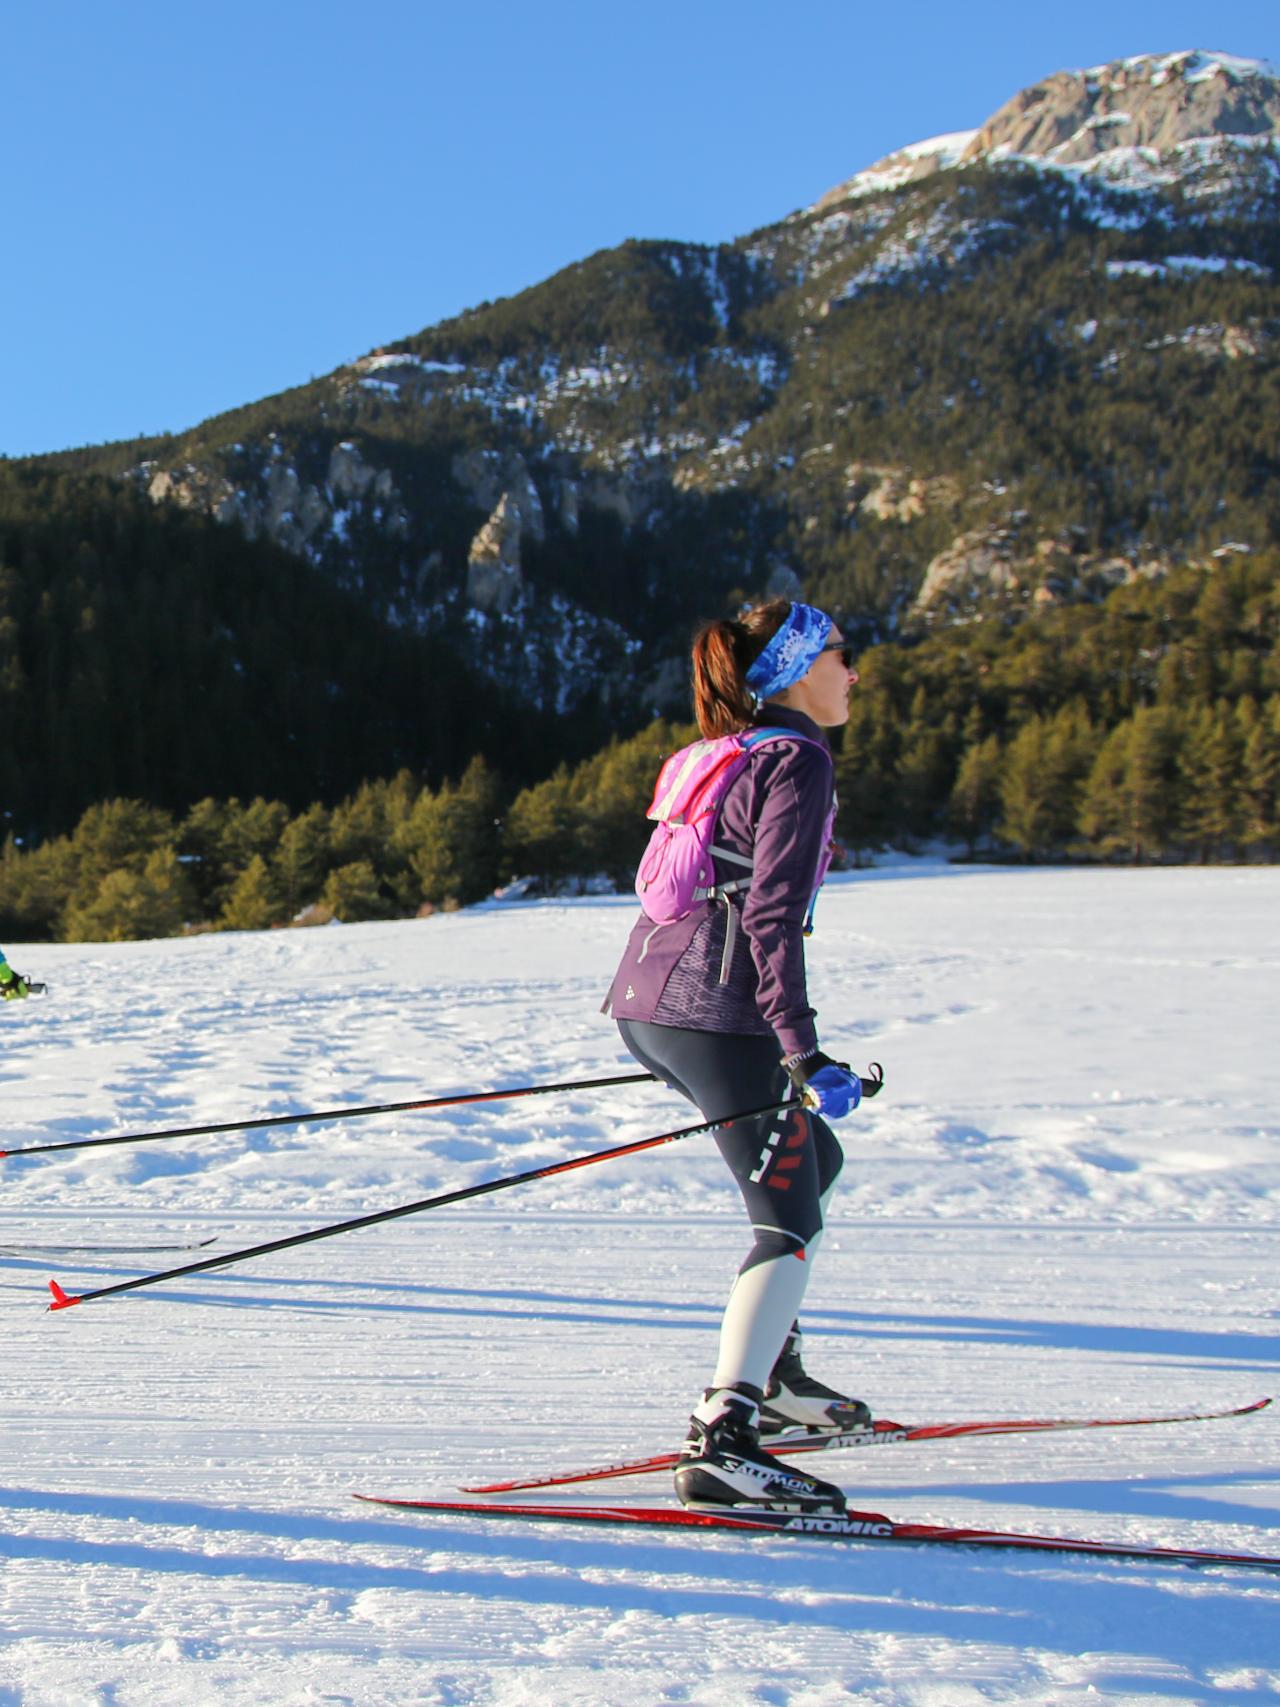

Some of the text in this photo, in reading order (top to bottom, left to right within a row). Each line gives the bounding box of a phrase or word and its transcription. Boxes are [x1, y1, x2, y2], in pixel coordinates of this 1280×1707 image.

[825, 1431, 907, 1448] ATOMIC
[722, 1459, 817, 1493] SALOMON
[783, 1517, 893, 1537] ATOMIC
